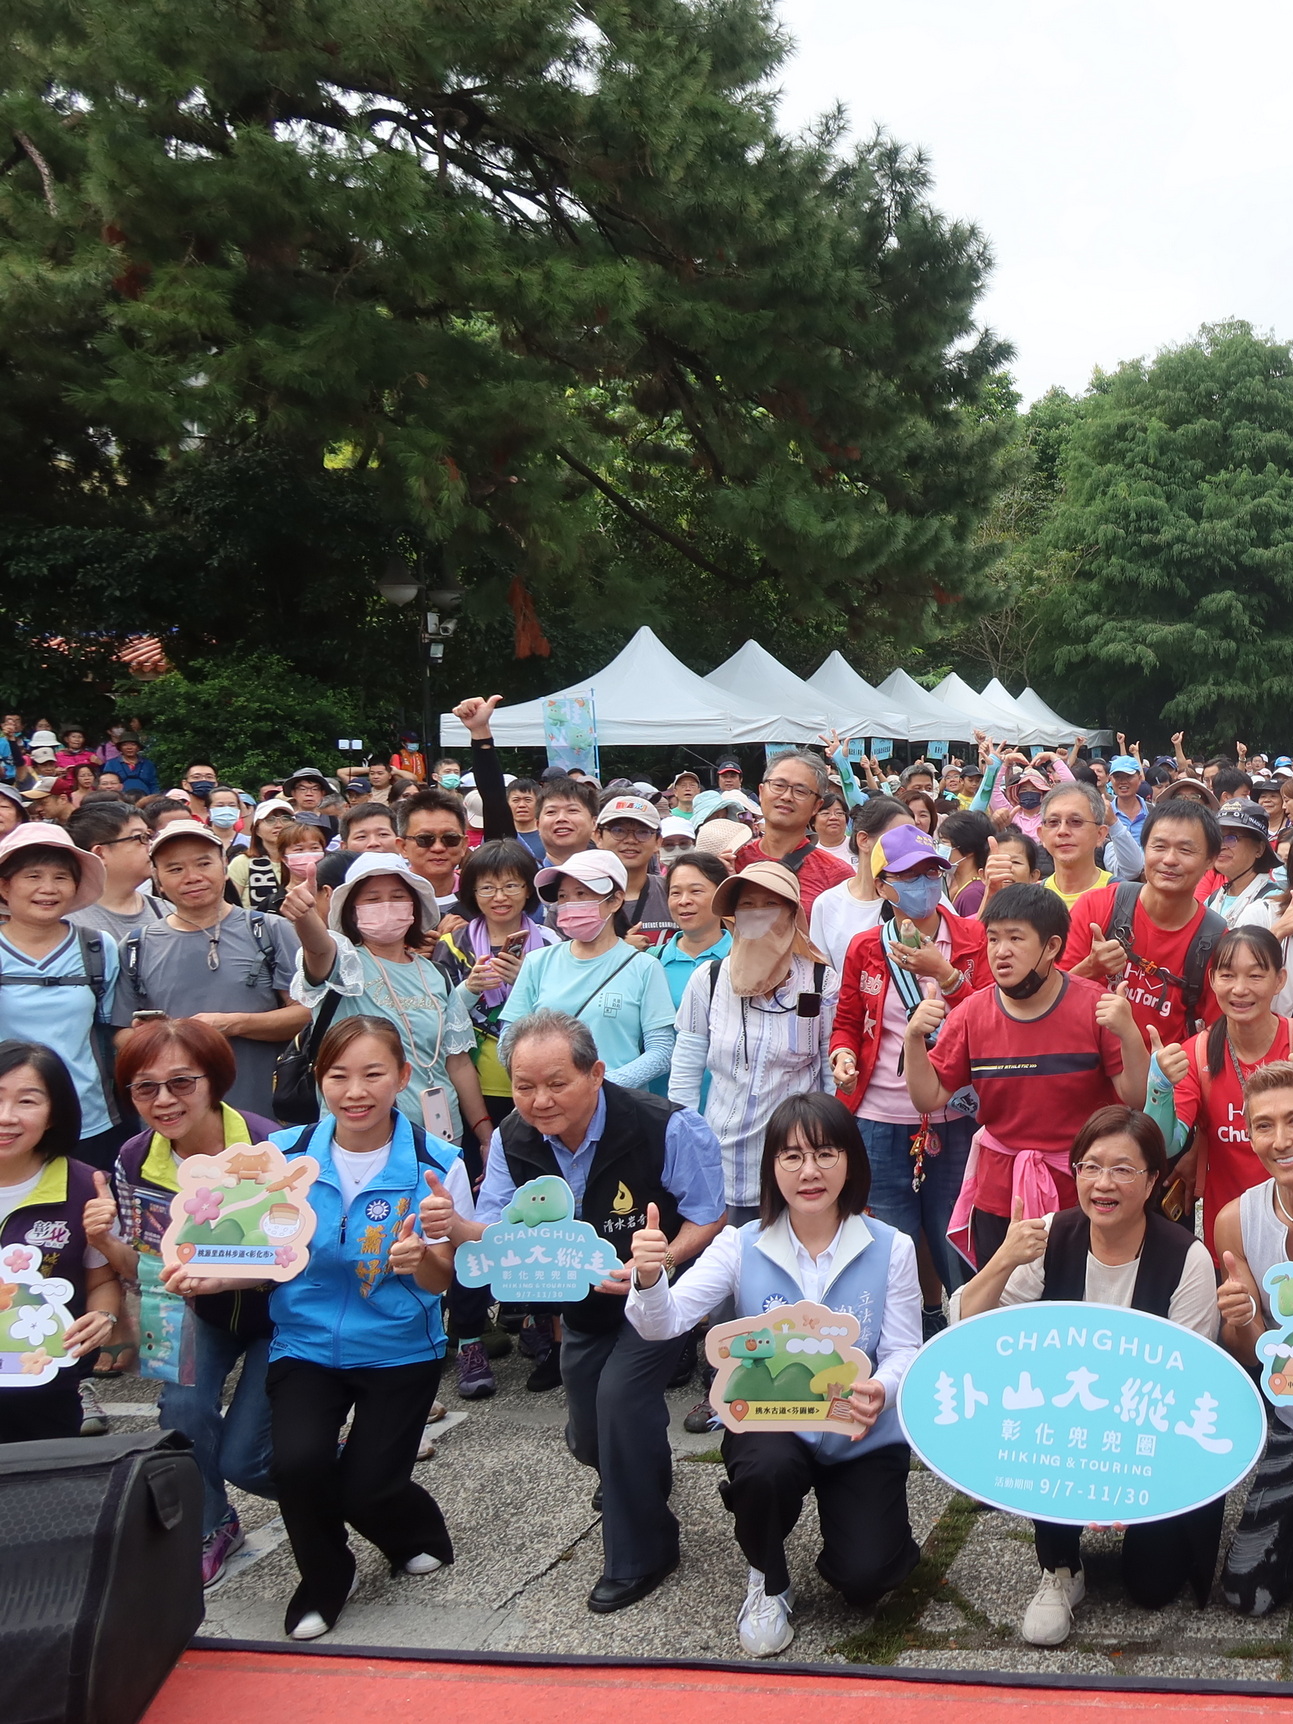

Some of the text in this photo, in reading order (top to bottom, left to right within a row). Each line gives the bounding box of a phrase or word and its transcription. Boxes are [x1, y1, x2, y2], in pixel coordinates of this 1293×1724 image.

[493, 1228, 586, 1245] CHANGHUA
[466, 1245, 612, 1277] 卦山大縱走
[996, 1327, 1185, 1371] CHANGHUA
[933, 1366, 1234, 1455] 卦山大縱走
[1001, 1418, 1157, 1458] 彰化兜兜圈
[998, 1449, 1153, 1477] HIKING & TOURING
[994, 1475, 1150, 1506] 活動期間 9/7-11/30
